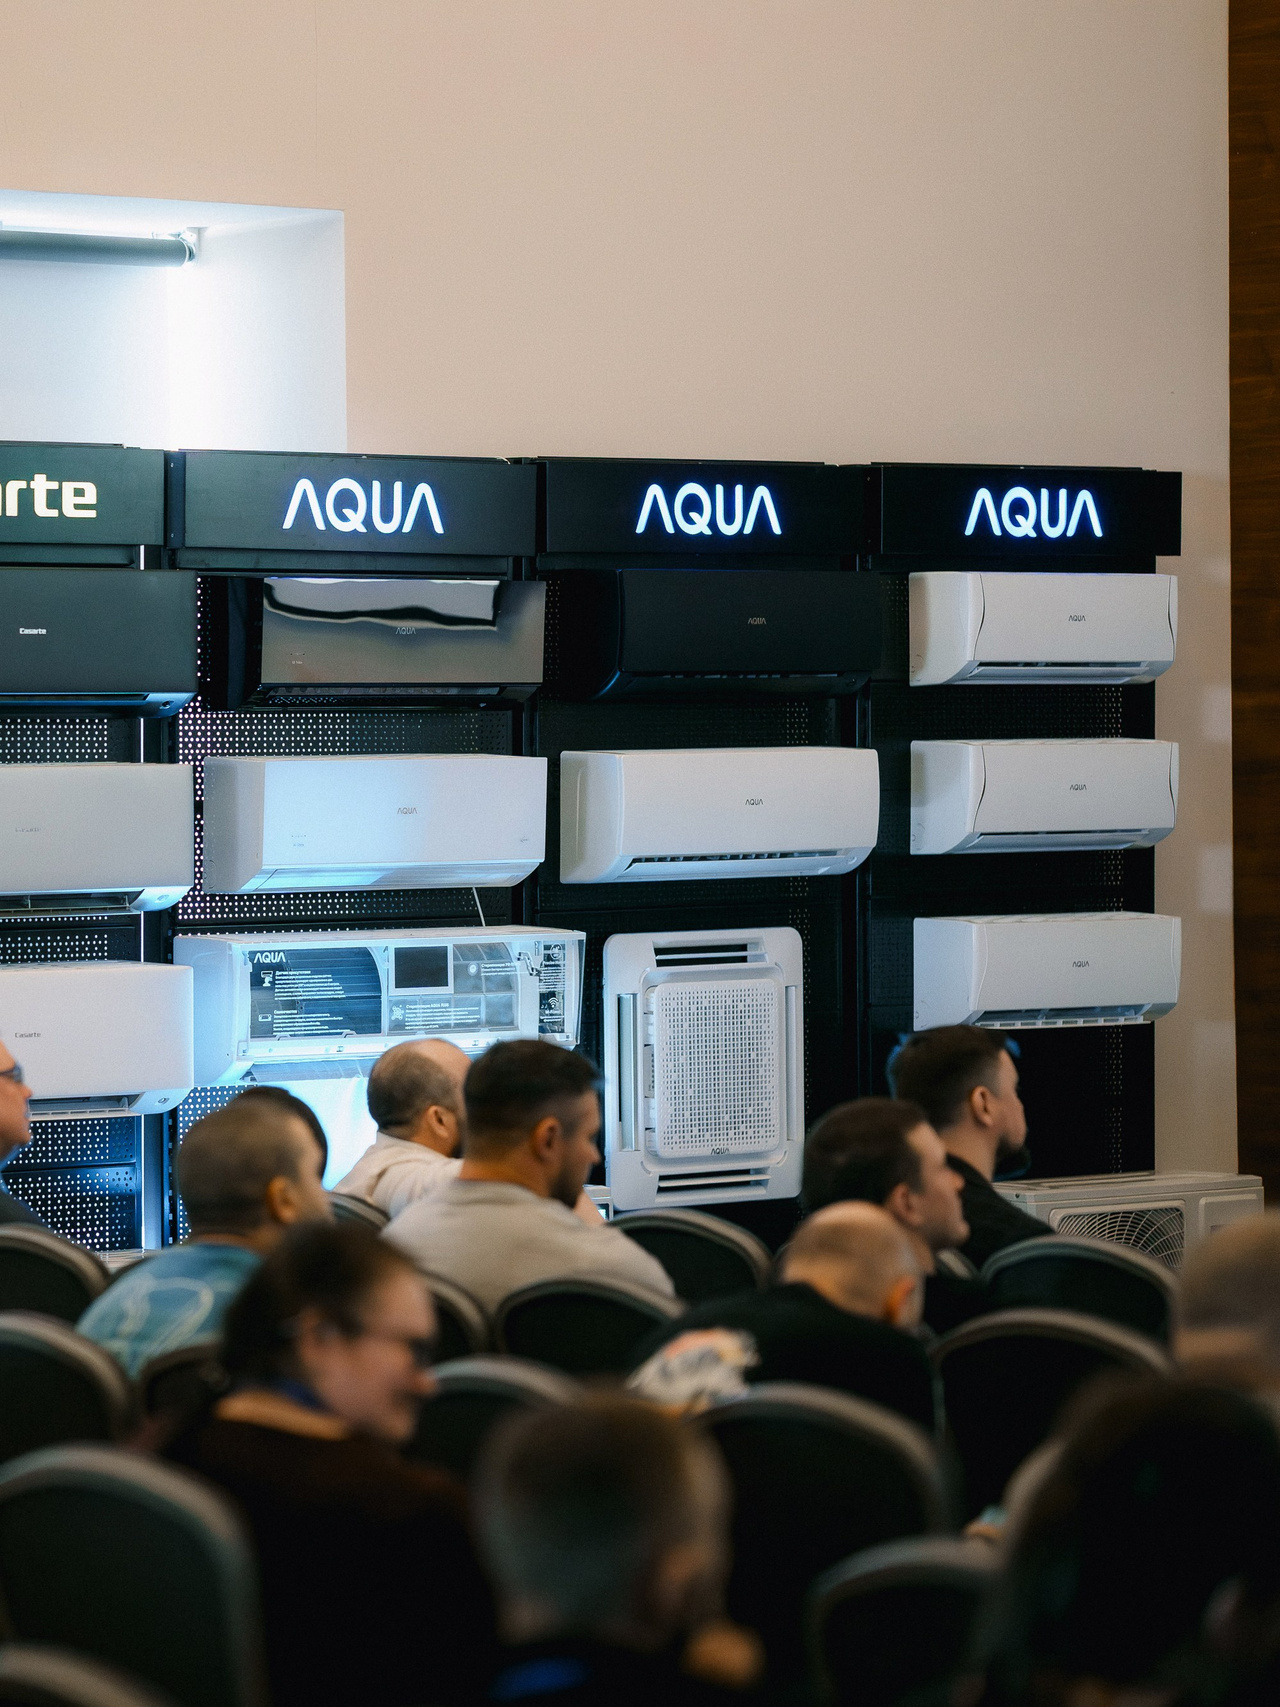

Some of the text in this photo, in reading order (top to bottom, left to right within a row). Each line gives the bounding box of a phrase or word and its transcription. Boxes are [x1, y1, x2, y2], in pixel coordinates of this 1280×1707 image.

[282, 477, 445, 534] AQUA
[635, 482, 783, 536] AQUA
[964, 486, 1104, 539] AQUA
[747, 617, 767, 625] AQUA
[1068, 614, 1087, 623] AQUA
[19, 627, 47, 635] Casarte
[395, 626, 417, 635] AQUA
[1069, 783, 1087, 791] AQUA
[744, 798, 764, 806] AQUA
[396, 807, 418, 815] AQUA
[253, 951, 287, 964] AQUA
[1072, 960, 1090, 968] AQUA
[710, 1147, 730, 1155] AQUA
